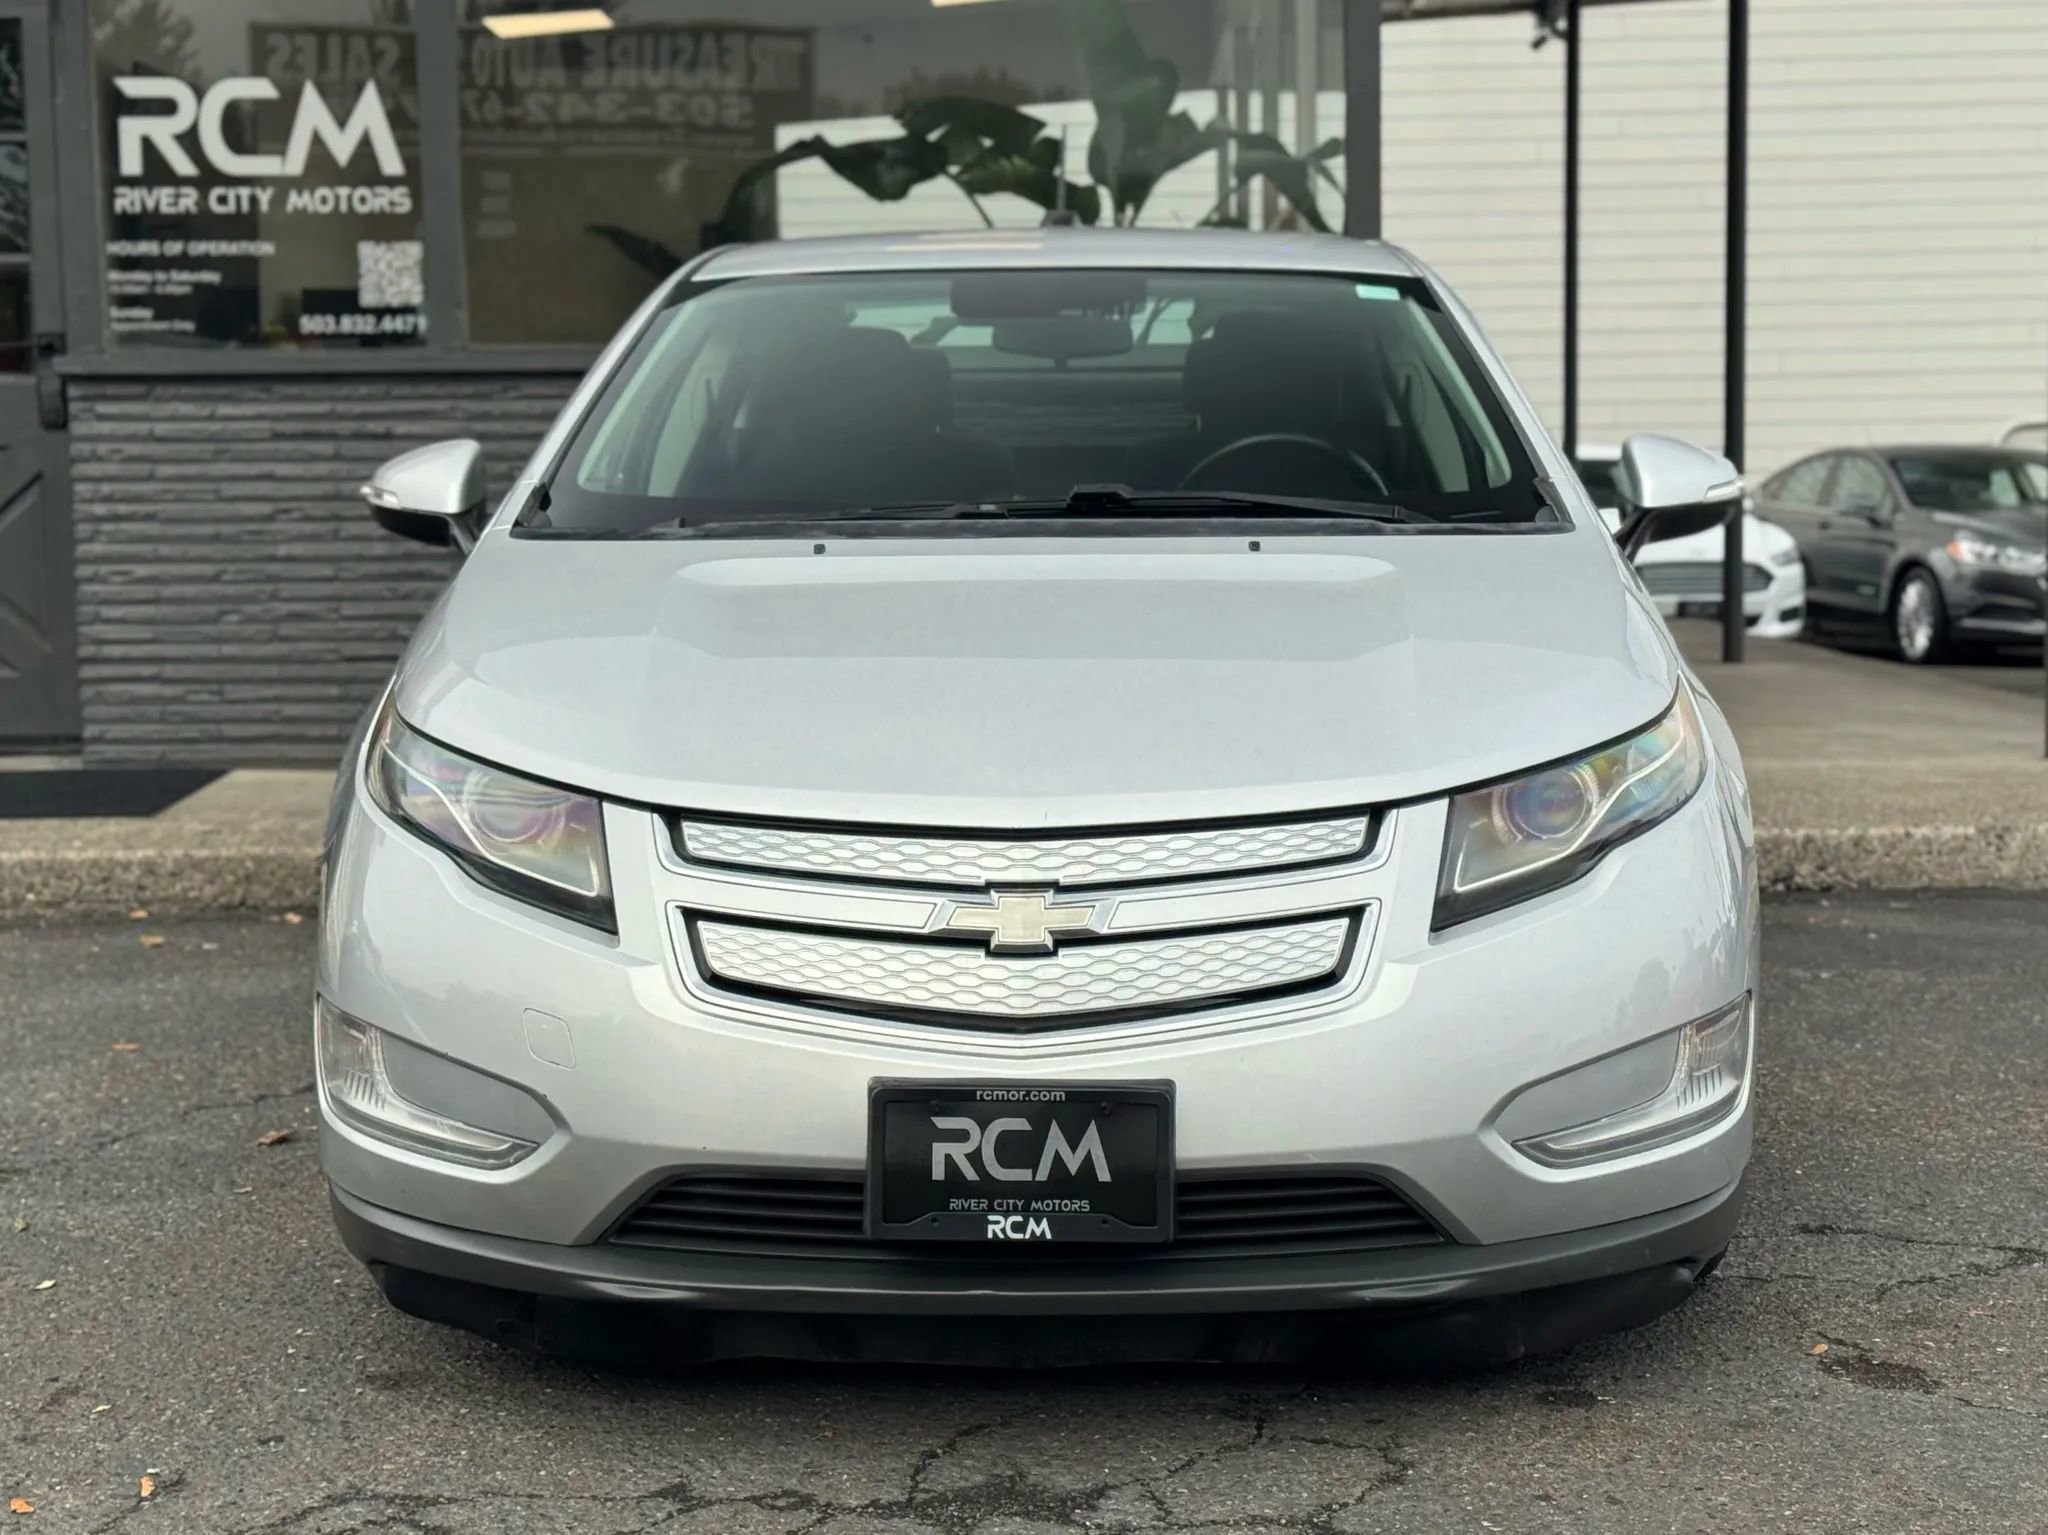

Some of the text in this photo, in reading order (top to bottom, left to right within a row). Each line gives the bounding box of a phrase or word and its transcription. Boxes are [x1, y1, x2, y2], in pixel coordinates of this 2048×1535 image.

[112, 76, 406, 177] RCM
[113, 186, 413, 215] RIVER CITY MOTORS
[298, 313, 427, 336] 503.832.4471
[975, 1089, 1066, 1102] rcmor.com
[930, 1116, 1112, 1182] RCM
[949, 1198, 1090, 1212] RIVER CITY MOTORS
[986, 1214, 1052, 1240] RCM
